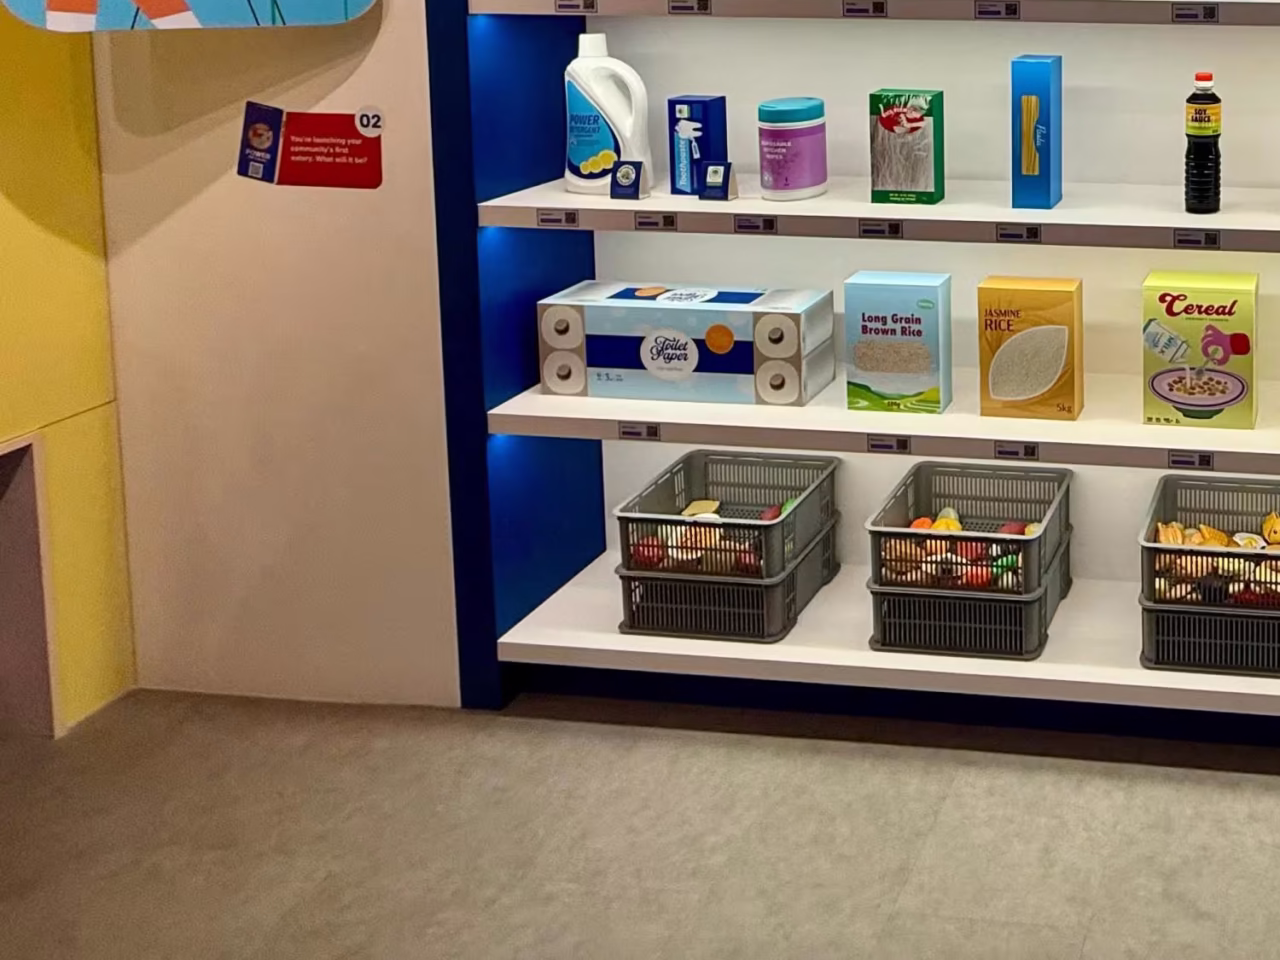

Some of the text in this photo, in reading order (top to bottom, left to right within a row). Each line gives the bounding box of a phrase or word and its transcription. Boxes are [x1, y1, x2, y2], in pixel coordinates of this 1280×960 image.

[1191, 115, 1211, 123] SAUCE
[1194, 108, 1208, 116] SOY
[359, 113, 382, 129] 02
[569, 113, 600, 126] POWER
[679, 139, 689, 186] Toothpaste
[1158, 292, 1239, 318] Cereal
[861, 312, 922, 326] Long Grain
[984, 309, 1022, 319] JASMINE
[861, 324, 923, 338] Brown Rice
[984, 319, 1015, 333] RICE
[654, 336, 689, 352] Toilet
[649, 345, 689, 364] Paper
[1056, 402, 1072, 413] 5kg
